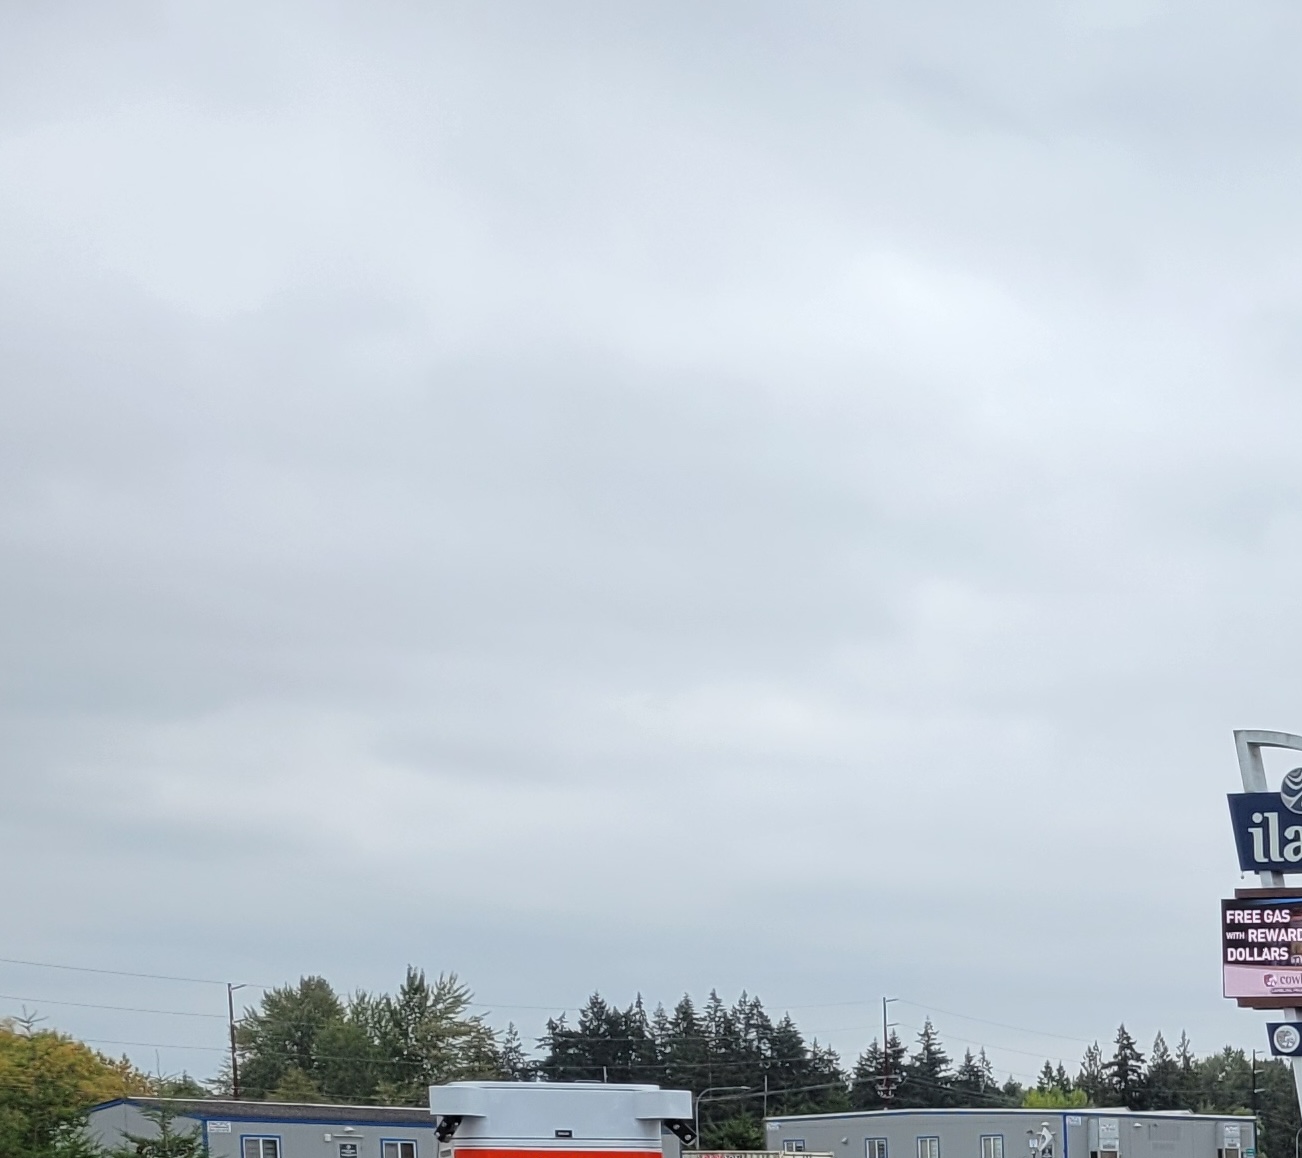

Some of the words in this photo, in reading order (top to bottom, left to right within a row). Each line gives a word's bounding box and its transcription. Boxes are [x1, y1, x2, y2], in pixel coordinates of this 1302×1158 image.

[1226, 910, 1262, 924] FREE
[1264, 909, 1291, 923] GAS
[1226, 931, 1245, 940] WITH
[1227, 947, 1289, 962] DOLLARS
